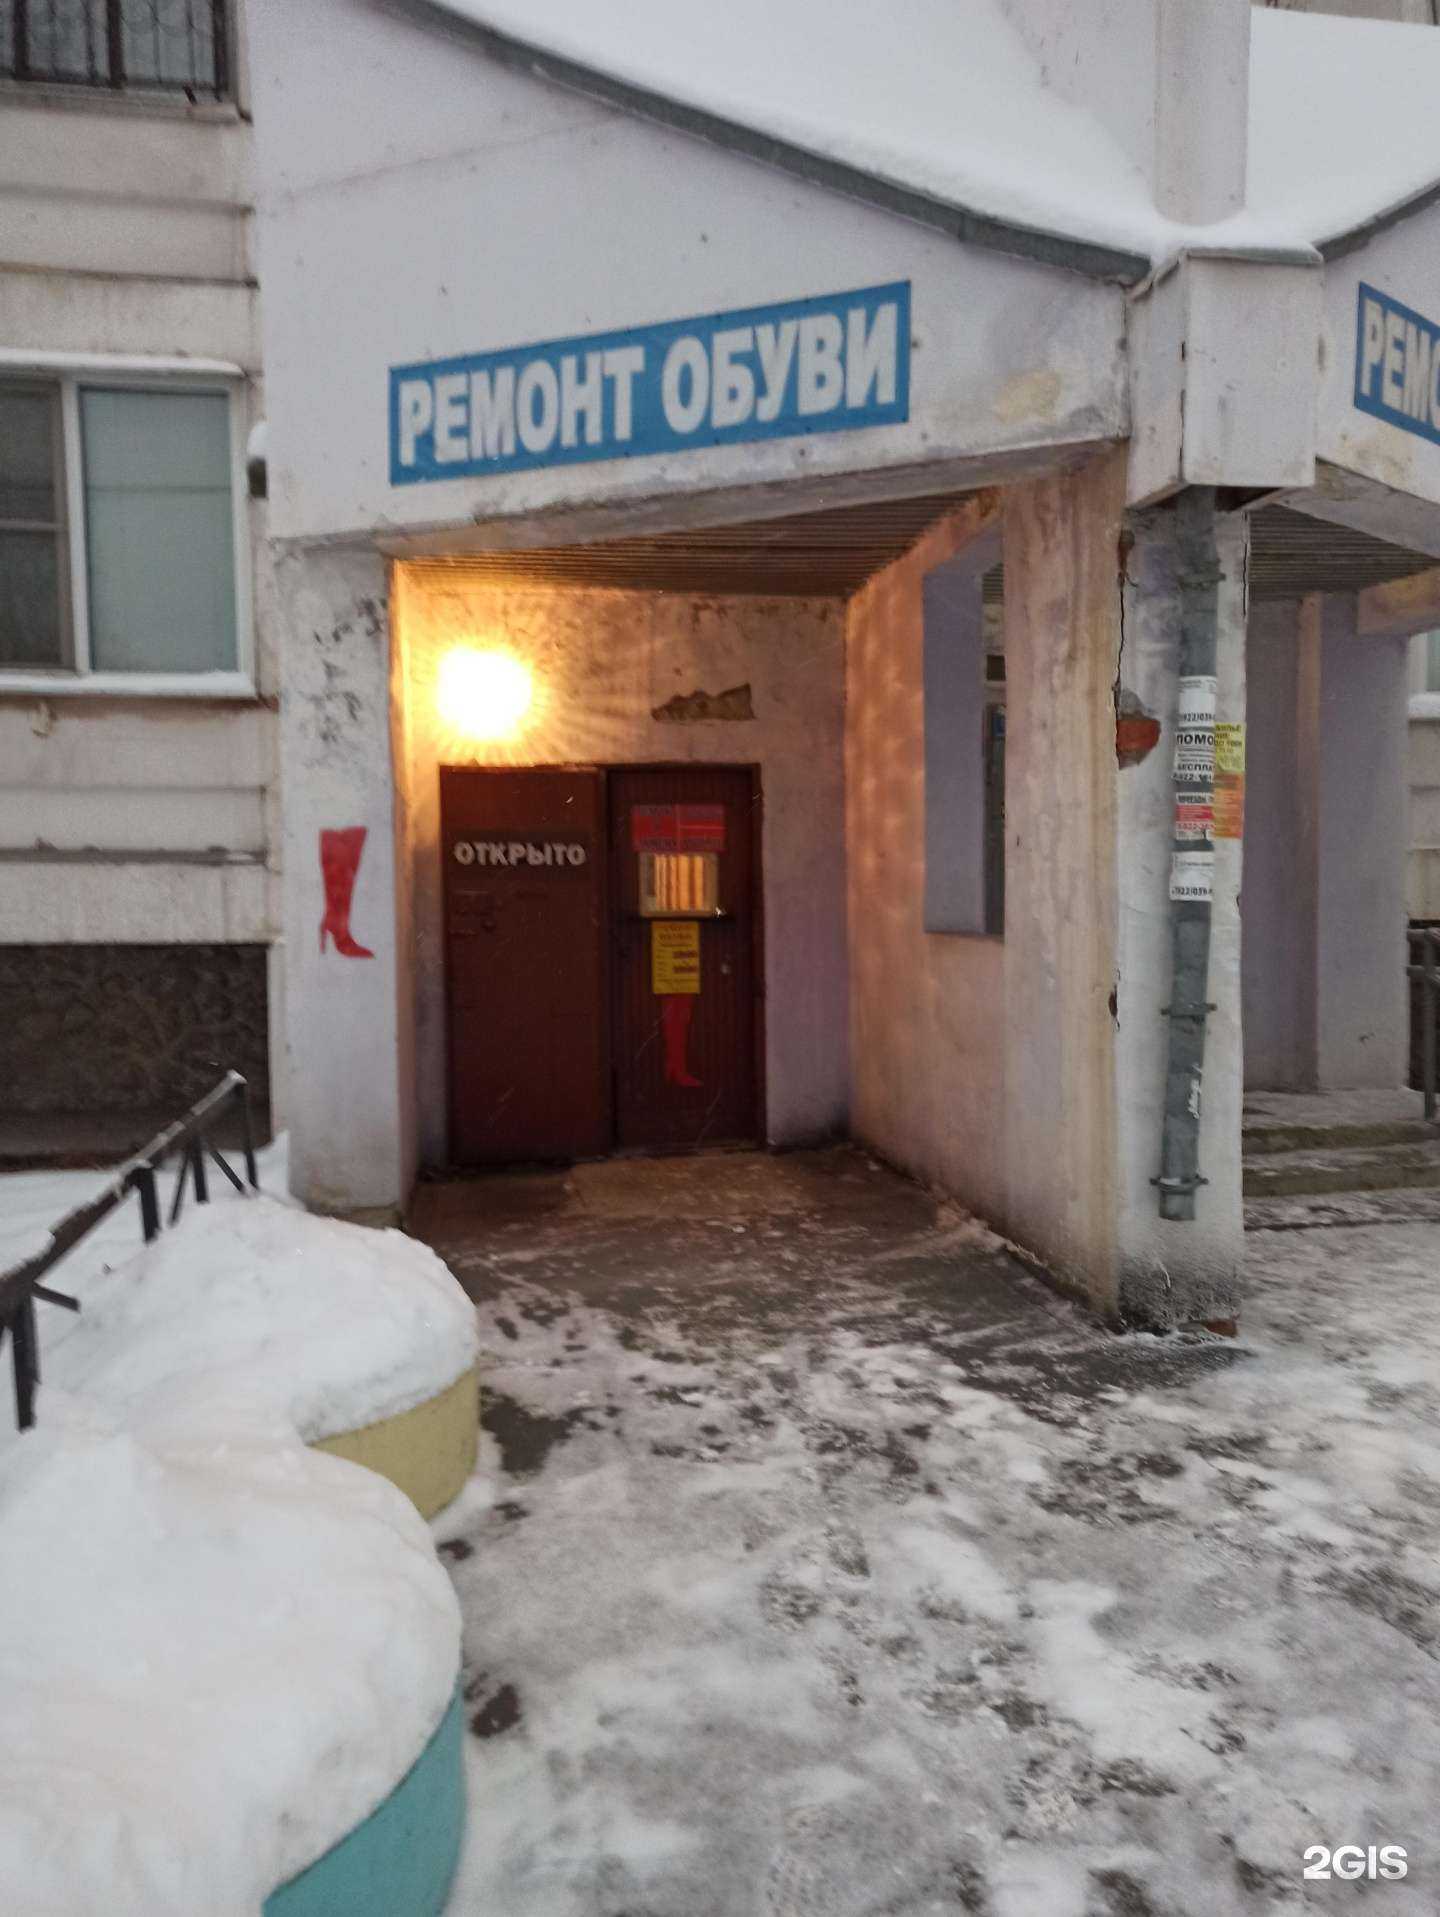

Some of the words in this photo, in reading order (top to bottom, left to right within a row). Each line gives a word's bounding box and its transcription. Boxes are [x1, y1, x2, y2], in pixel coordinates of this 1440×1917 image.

[400, 345, 645, 467] РЕМОНТ
[661, 302, 898, 435] ОБУВИ
[1176, 734, 1216, 746] ПОМО
[453, 841, 587, 867] ОТКРЫТО
